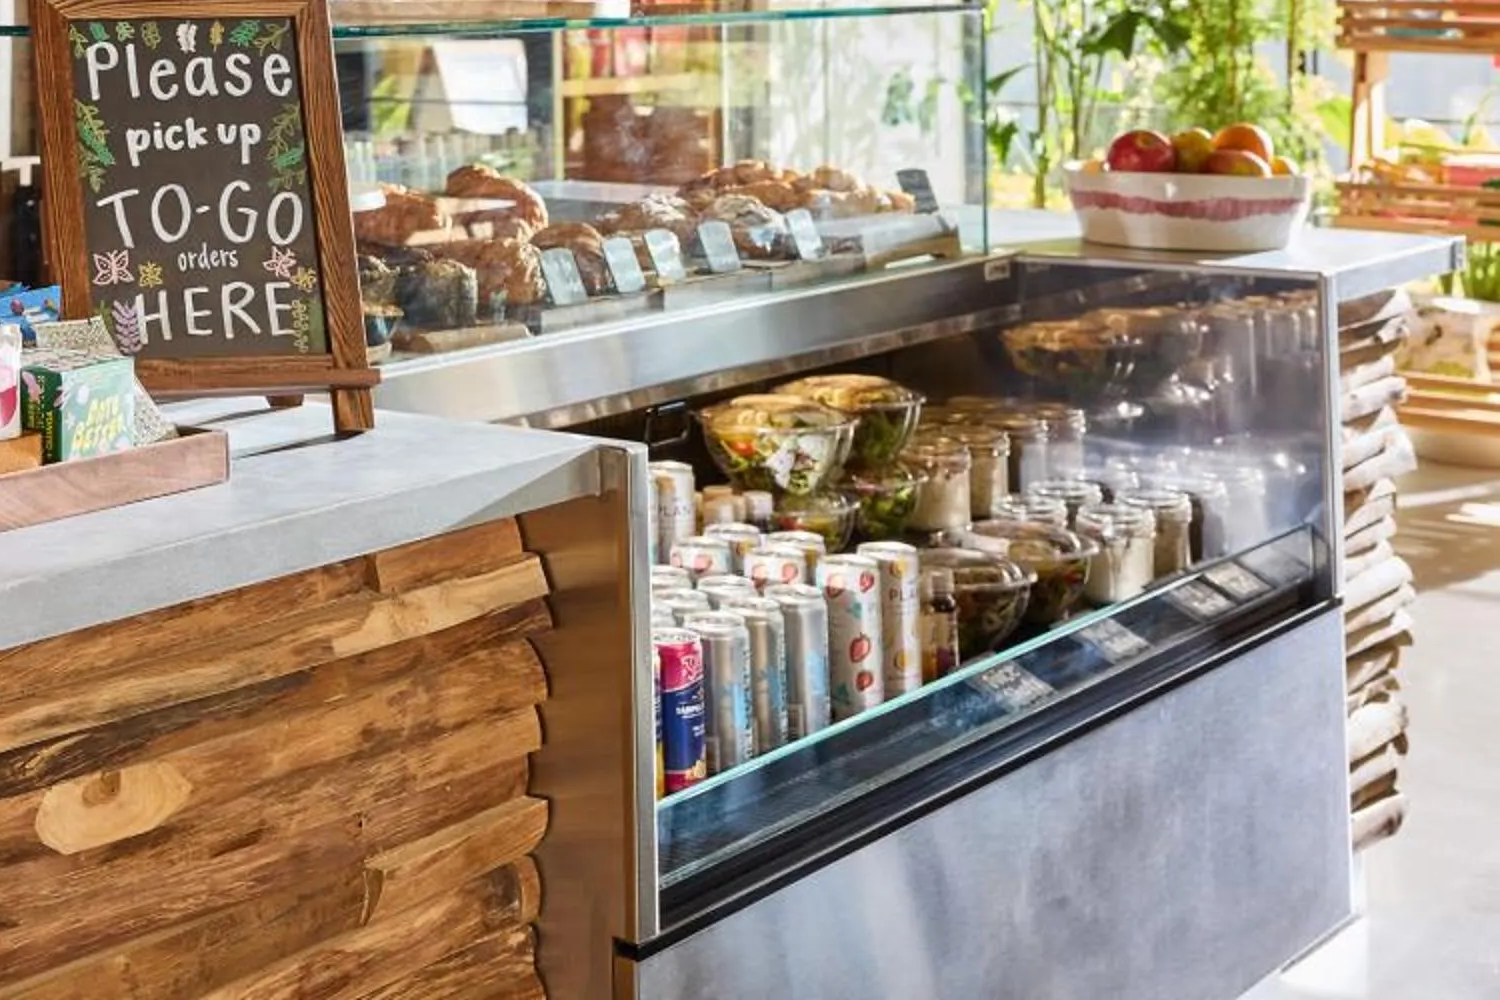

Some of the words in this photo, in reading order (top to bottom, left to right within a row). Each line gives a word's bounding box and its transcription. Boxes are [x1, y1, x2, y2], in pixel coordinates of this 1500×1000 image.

[85, 40, 293, 101] Please
[125, 116, 208, 167] pick
[217, 122, 262, 165] up
[96, 179, 302, 249] TO-GO
[177, 242, 239, 272] orders
[134, 280, 297, 345] HERE
